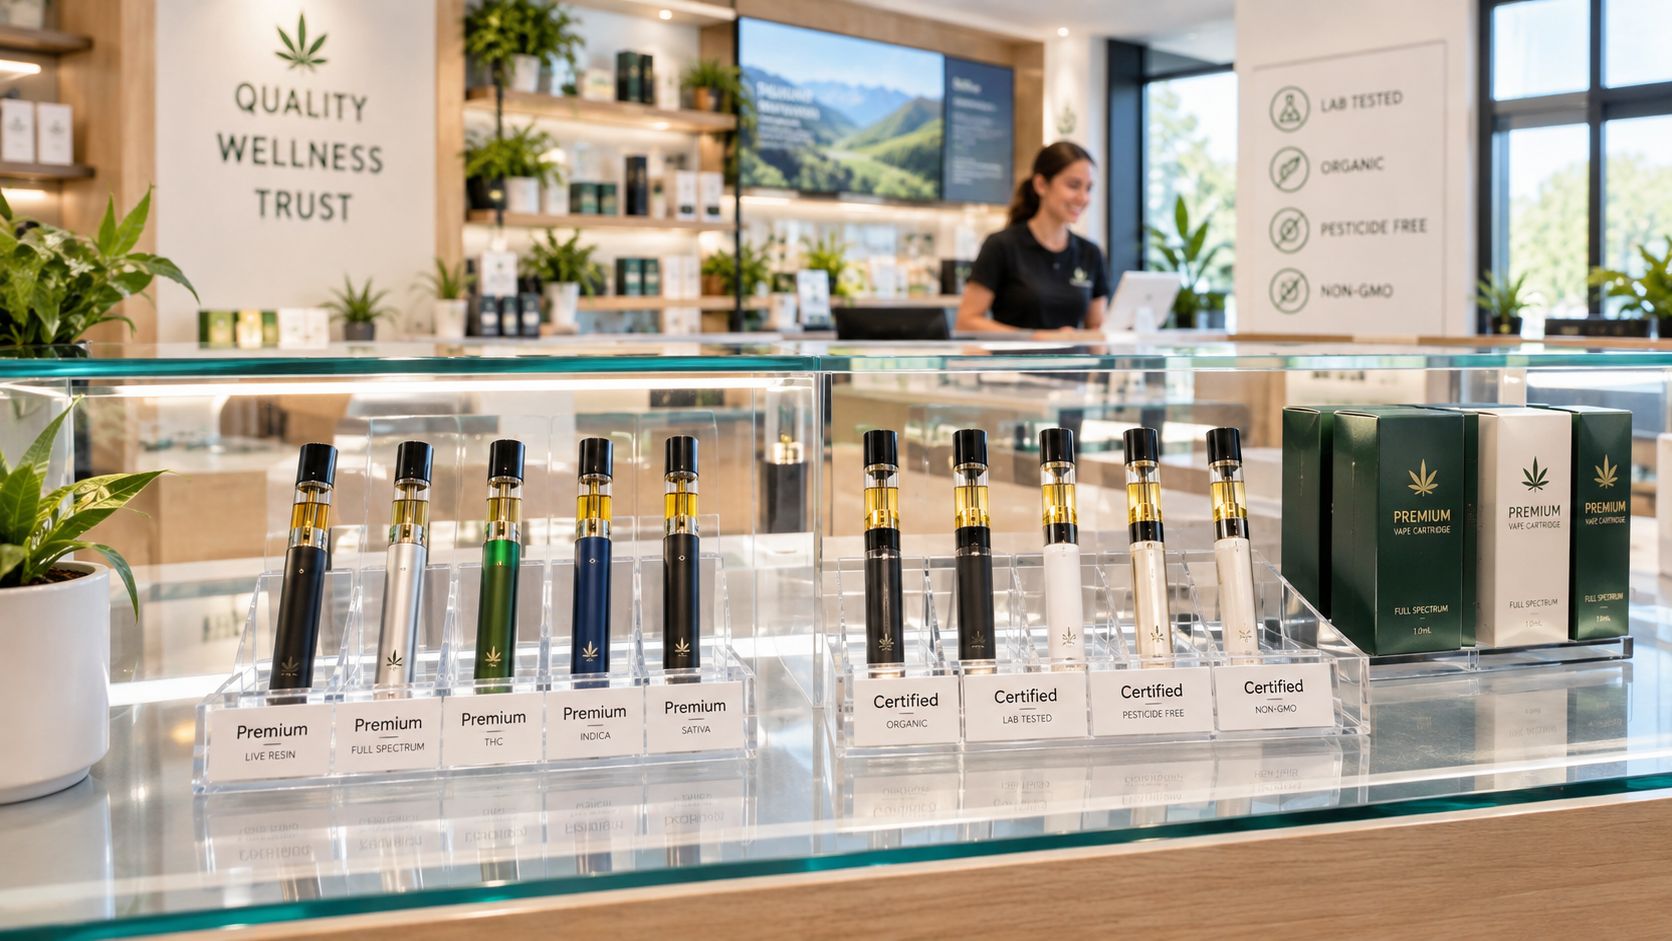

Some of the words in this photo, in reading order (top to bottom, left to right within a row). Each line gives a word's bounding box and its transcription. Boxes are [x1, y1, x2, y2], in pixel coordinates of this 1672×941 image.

[235, 82, 368, 122] QUALITY
[1321, 96, 1347, 113] LAB
[1352, 89, 1404, 109] TESTED
[217, 132, 384, 174] WELLNESS
[1321, 156, 1384, 175] ORGANIC
[255, 188, 353, 222] TRUST
[1321, 220, 1388, 237] PESTICIDE
[1393, 217, 1428, 234] FREE
[1321, 282, 1394, 298] NON-GMO
[1508, 505, 1561, 518] PREMIUM
[1585, 501, 1626, 514] PREMIUM
[1394, 509, 1451, 524] PREMIUM
[1393, 527, 1411, 536] VAPE
[1508, 522, 1524, 530] VAPE
[1394, 607, 1411, 615] FULL
[1412, 605, 1449, 614] SPECTRUM
[1509, 600, 1524, 609] FULL
[1121, 683, 1183, 699] Certified
[1244, 679, 1304, 694] Certified
[873, 693, 939, 709] Certified
[994, 688, 1057, 704] Certified
[563, 705, 627, 720] Premium
[665, 699, 726, 714] Premium
[1122, 709, 1163, 719] PESTICIDE
[1165, 708, 1185, 718] FREE
[1255, 704, 1297, 714] NON-GMO
[355, 716, 422, 732] Premium
[461, 711, 526, 726] Premium
[886, 719, 928, 729] ORGANIC
[1002, 715, 1019, 725] LAB
[1021, 714, 1053, 724] TESTED
[236, 723, 308, 740] Premium
[580, 731, 611, 741] INDICA
[681, 725, 711, 735] SATIVA
[351, 745, 373, 755] FULL
[375, 742, 425, 754] SPECTRUM
[484, 737, 503, 747] THC
[245, 752, 265, 762] LIVE
[268, 750, 296, 761] RESIN
